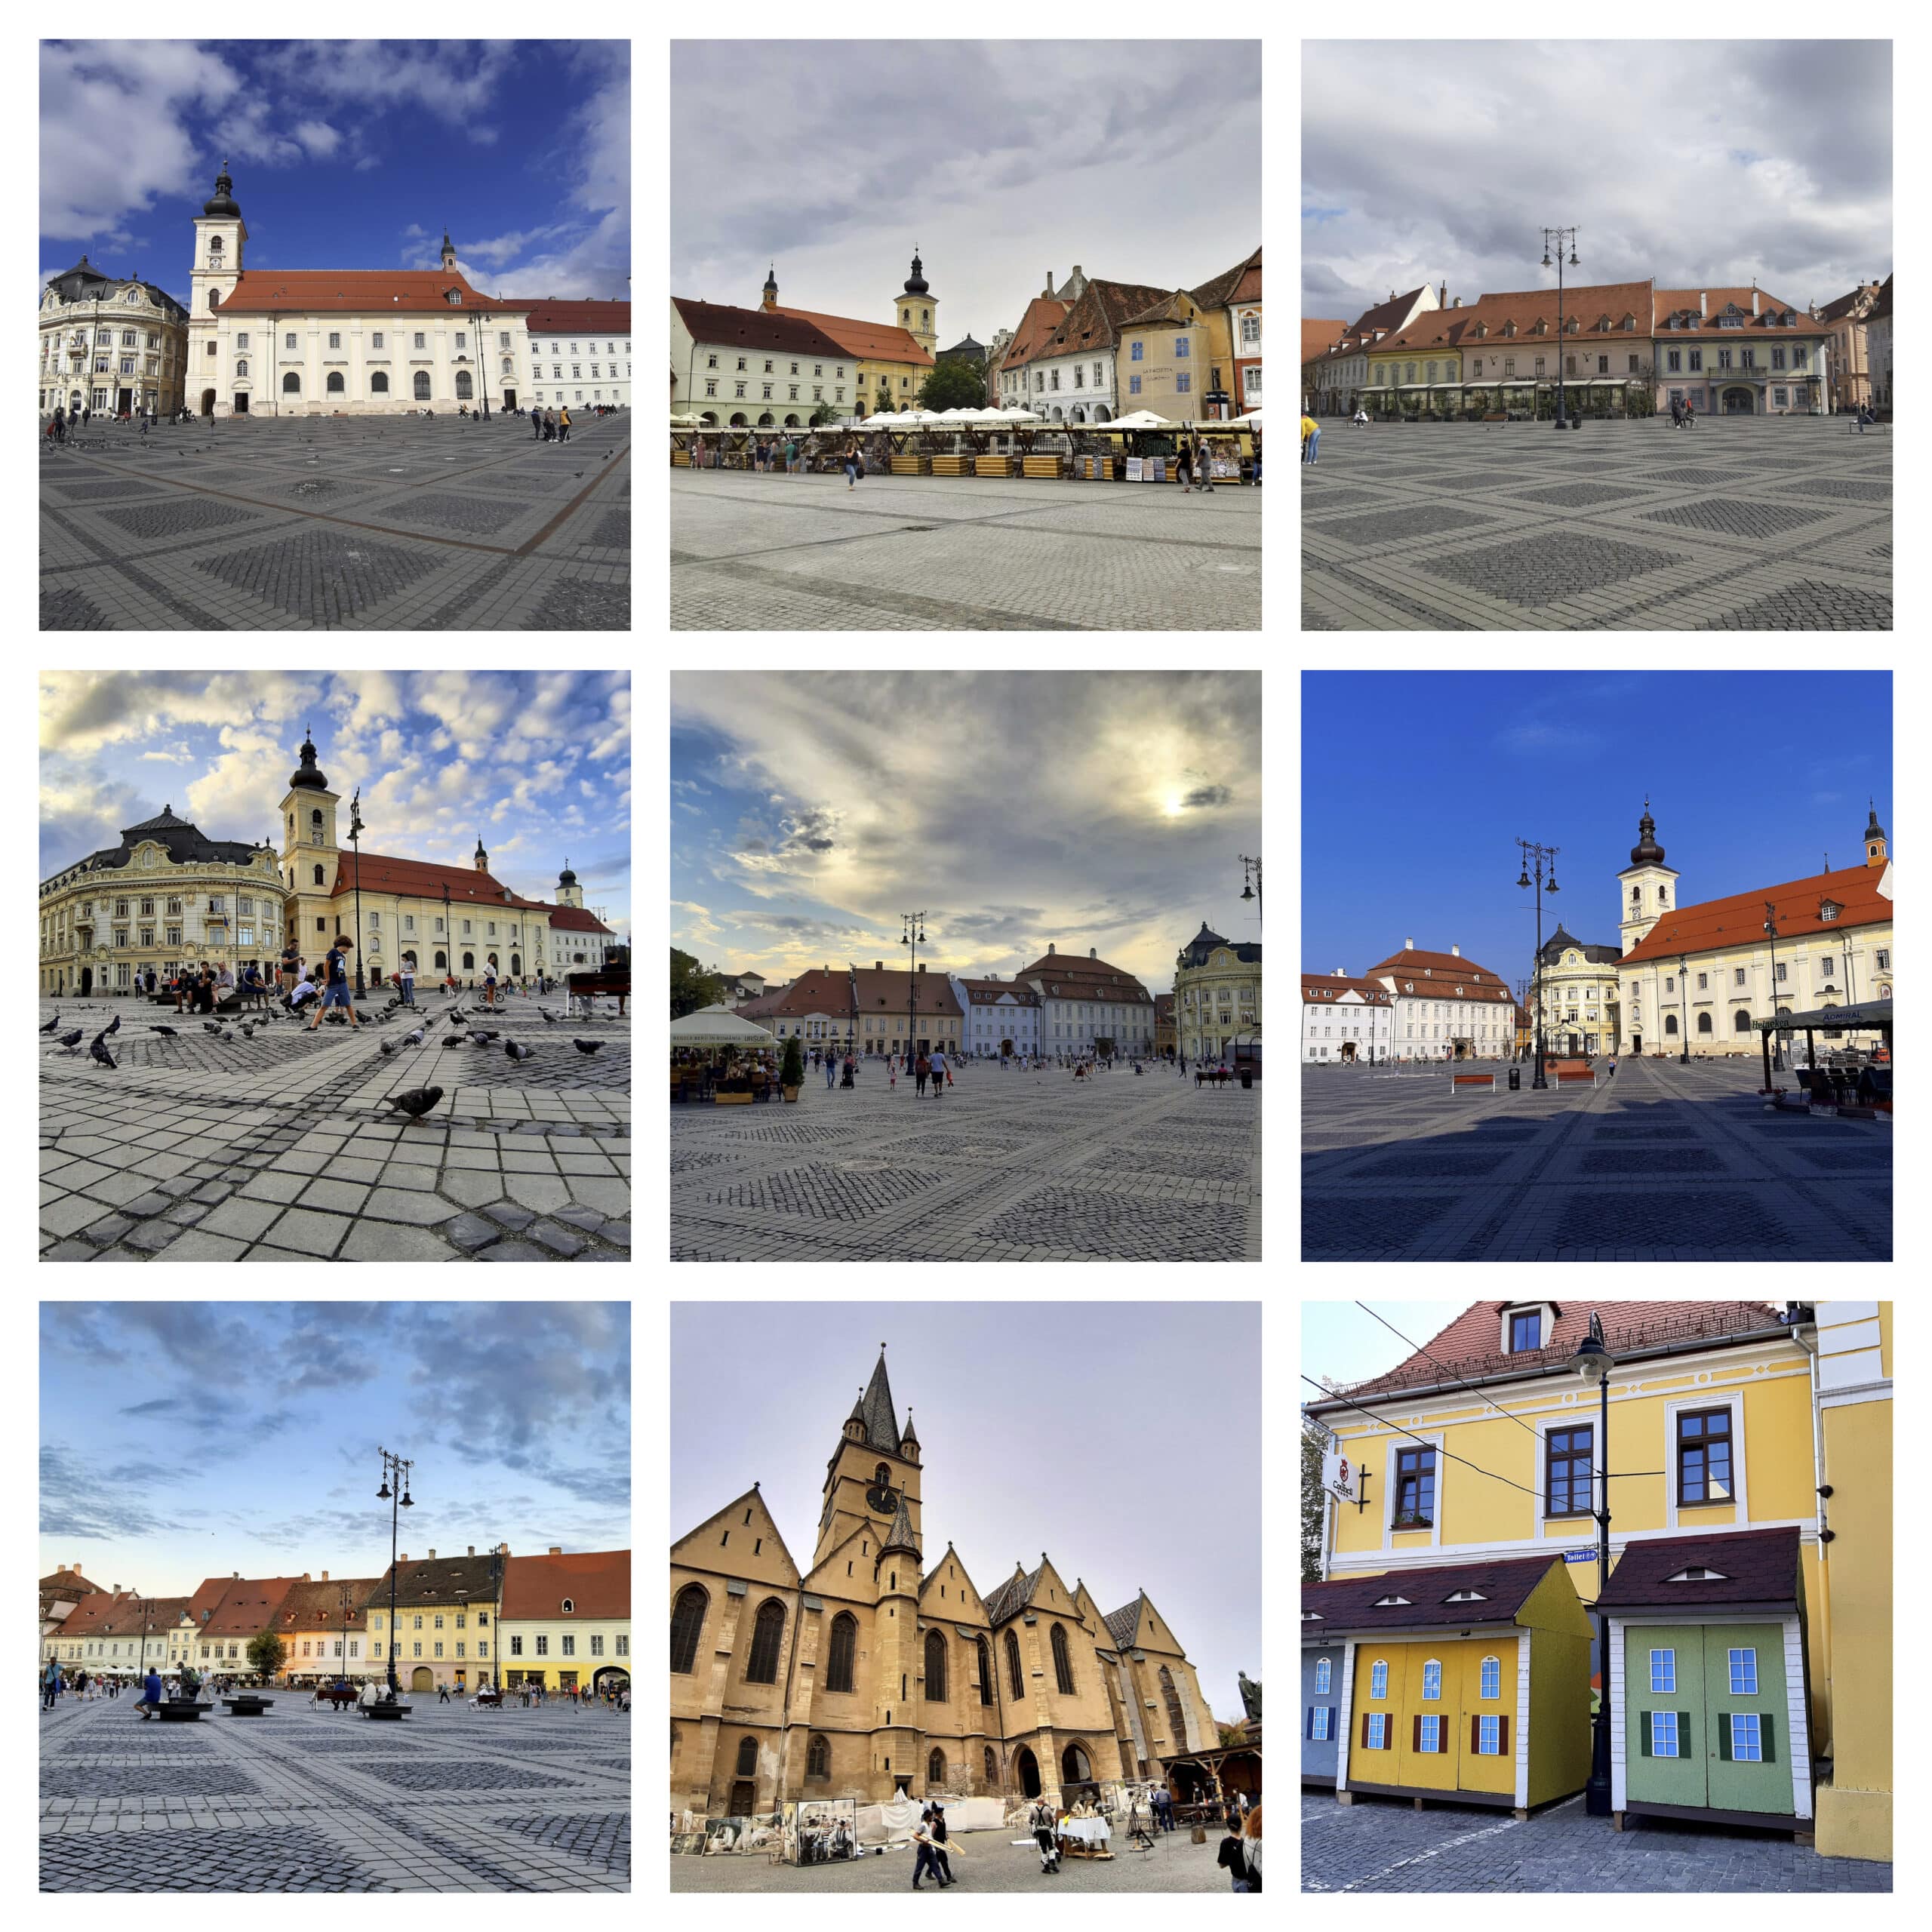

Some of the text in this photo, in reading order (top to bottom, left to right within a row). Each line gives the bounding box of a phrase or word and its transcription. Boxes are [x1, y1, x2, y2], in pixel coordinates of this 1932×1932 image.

[1823, 1010, 1860, 1021] ADMIRAL
[1752, 1019, 1789, 1029] Heineken
[1333, 1480, 1352, 1496] Council
[1567, 1553, 1585, 1561] Toilet
